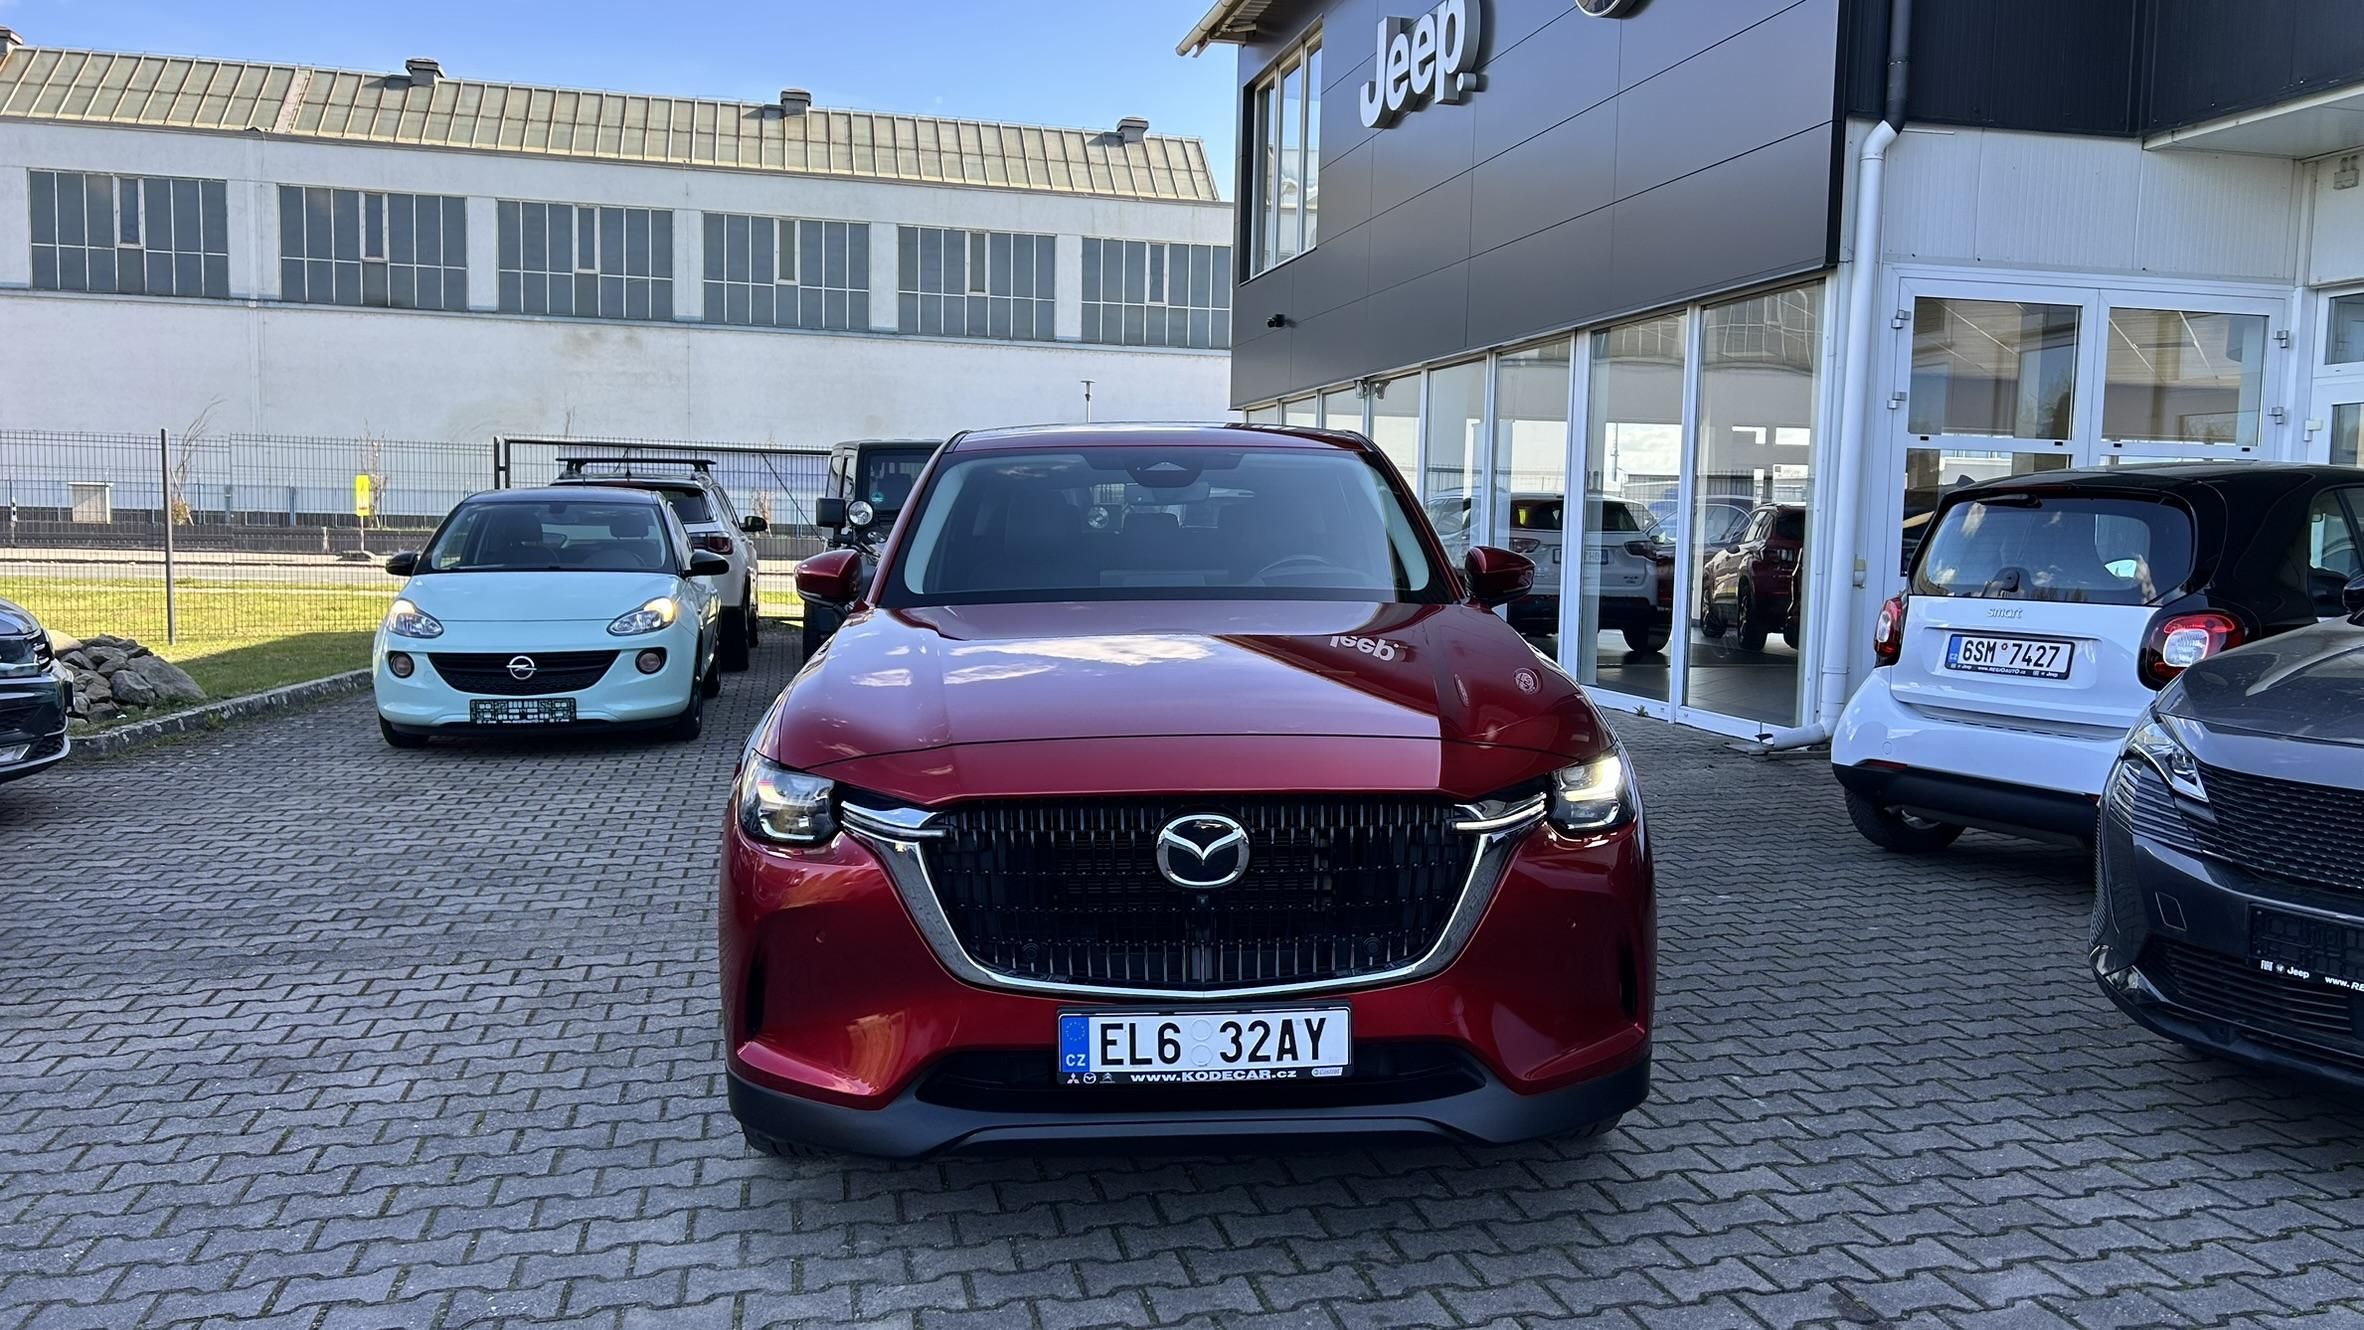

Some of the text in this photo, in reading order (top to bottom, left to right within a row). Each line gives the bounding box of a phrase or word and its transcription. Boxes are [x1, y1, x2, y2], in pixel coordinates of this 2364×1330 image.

[1360, 0, 1480, 128] Jeep
[1986, 607, 2024, 619] smart
[1962, 640, 2061, 668] 6SM 7427
[2287, 966, 2310, 979] Jeep
[1100, 1017, 1328, 1066] EL6 32AY
[1065, 1053, 1087, 1068] CZ
[1130, 1069, 1297, 1083] www.KODECAR.cz
